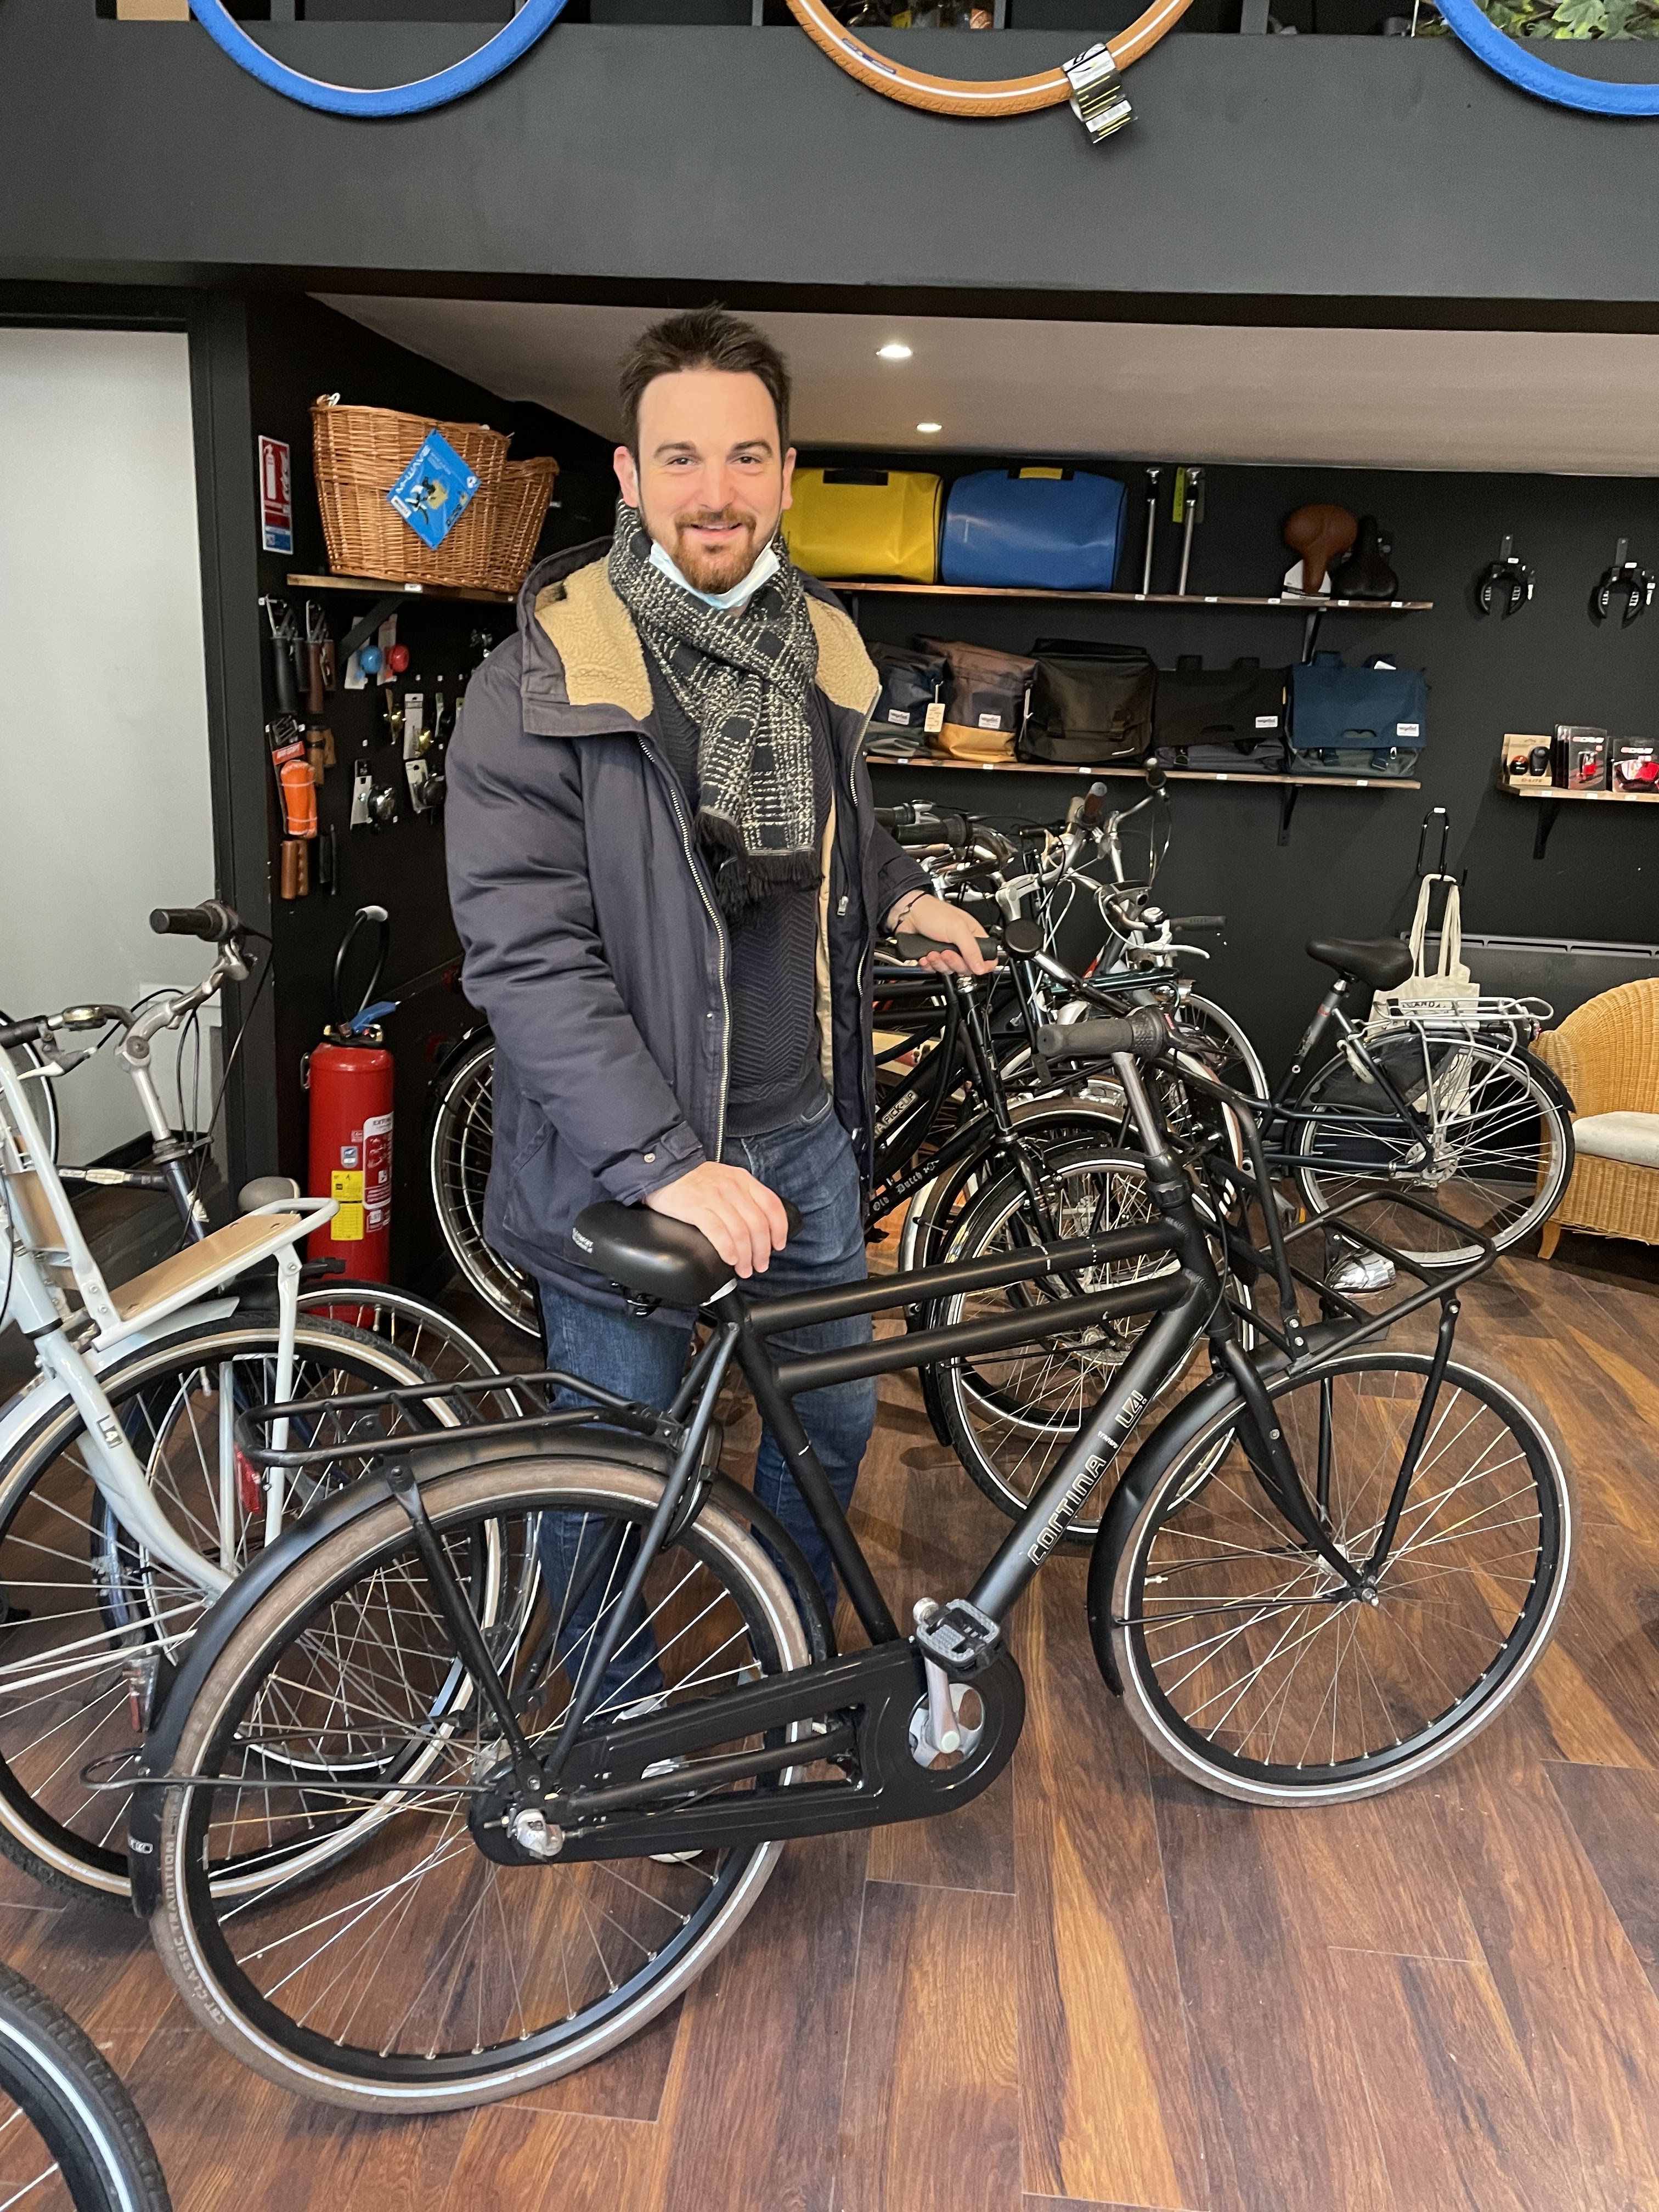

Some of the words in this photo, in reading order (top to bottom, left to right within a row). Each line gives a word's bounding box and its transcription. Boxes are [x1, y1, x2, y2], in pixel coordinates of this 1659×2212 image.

[883, 1092, 915, 1124] PICK-UP
[872, 1197, 890, 1211] Old
[895, 1171, 923, 1195] Dutch
[1026, 1454, 1107, 1566] CORTINA
[165, 1841, 180, 1934] TRADITION
